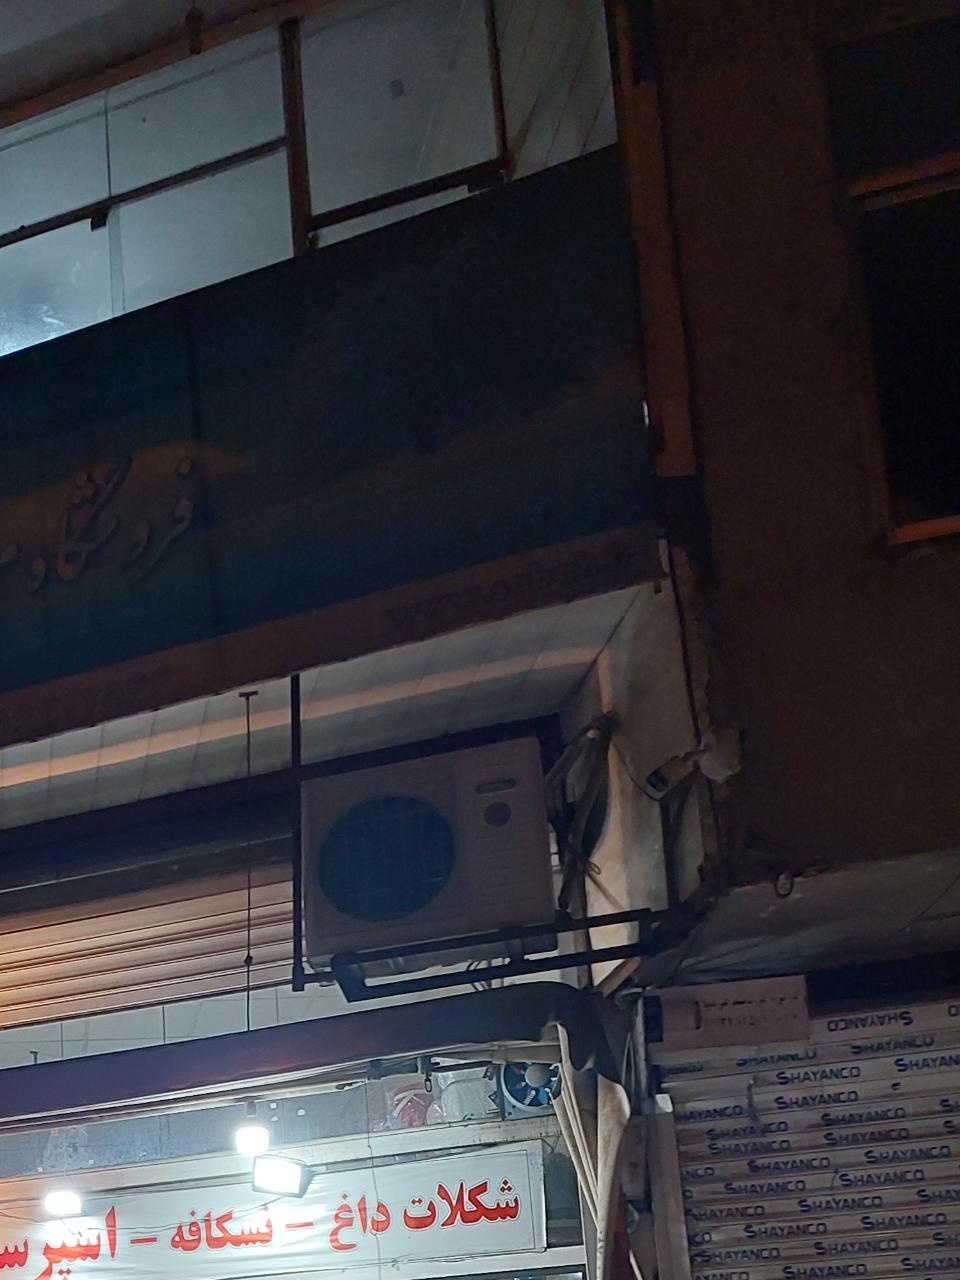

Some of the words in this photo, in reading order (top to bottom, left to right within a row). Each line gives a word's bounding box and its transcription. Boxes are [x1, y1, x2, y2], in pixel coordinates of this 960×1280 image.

[827, 1011, 913, 1031] SHAYANCO
[776, 1066, 860, 1085] SHAYANCO
[894, 1057, 960, 1072] SHAYAN
[675, 1105, 743, 1121] HAYANCO
[774, 1091, 859, 1110] SHAYANCO
[821, 1107, 906, 1127] SHAYANCO
[708, 1139, 790, 1157] SHAYANCO
[824, 1130, 909, 1147] SHAYANCO
[747, 1157, 830, 1173] SHAYANCO
[864, 1145, 951, 1164] SHAYANCO
[724, 1180, 806, 1195] SHAYANCO
[840, 1169, 925, 1187] SHAYANCO
[403, 1178, 521, 1230] شکلات
[798, 1196, 883, 1213] SHAYANCO
[917, 1188, 960, 1204] SHAY
[170, 1205, 274, 1252] نسکافه
[329, 1192, 392, 1252] داغ
[744, 1223, 827, 1238] SHAYANCO
[860, 1213, 947, 1230] SHAYANCO
[814, 1239, 898, 1255] SHAYANCO
[782, 1263, 867, 1280] SHAYANCO
[900, 1257, 960, 1271] SHAYA
